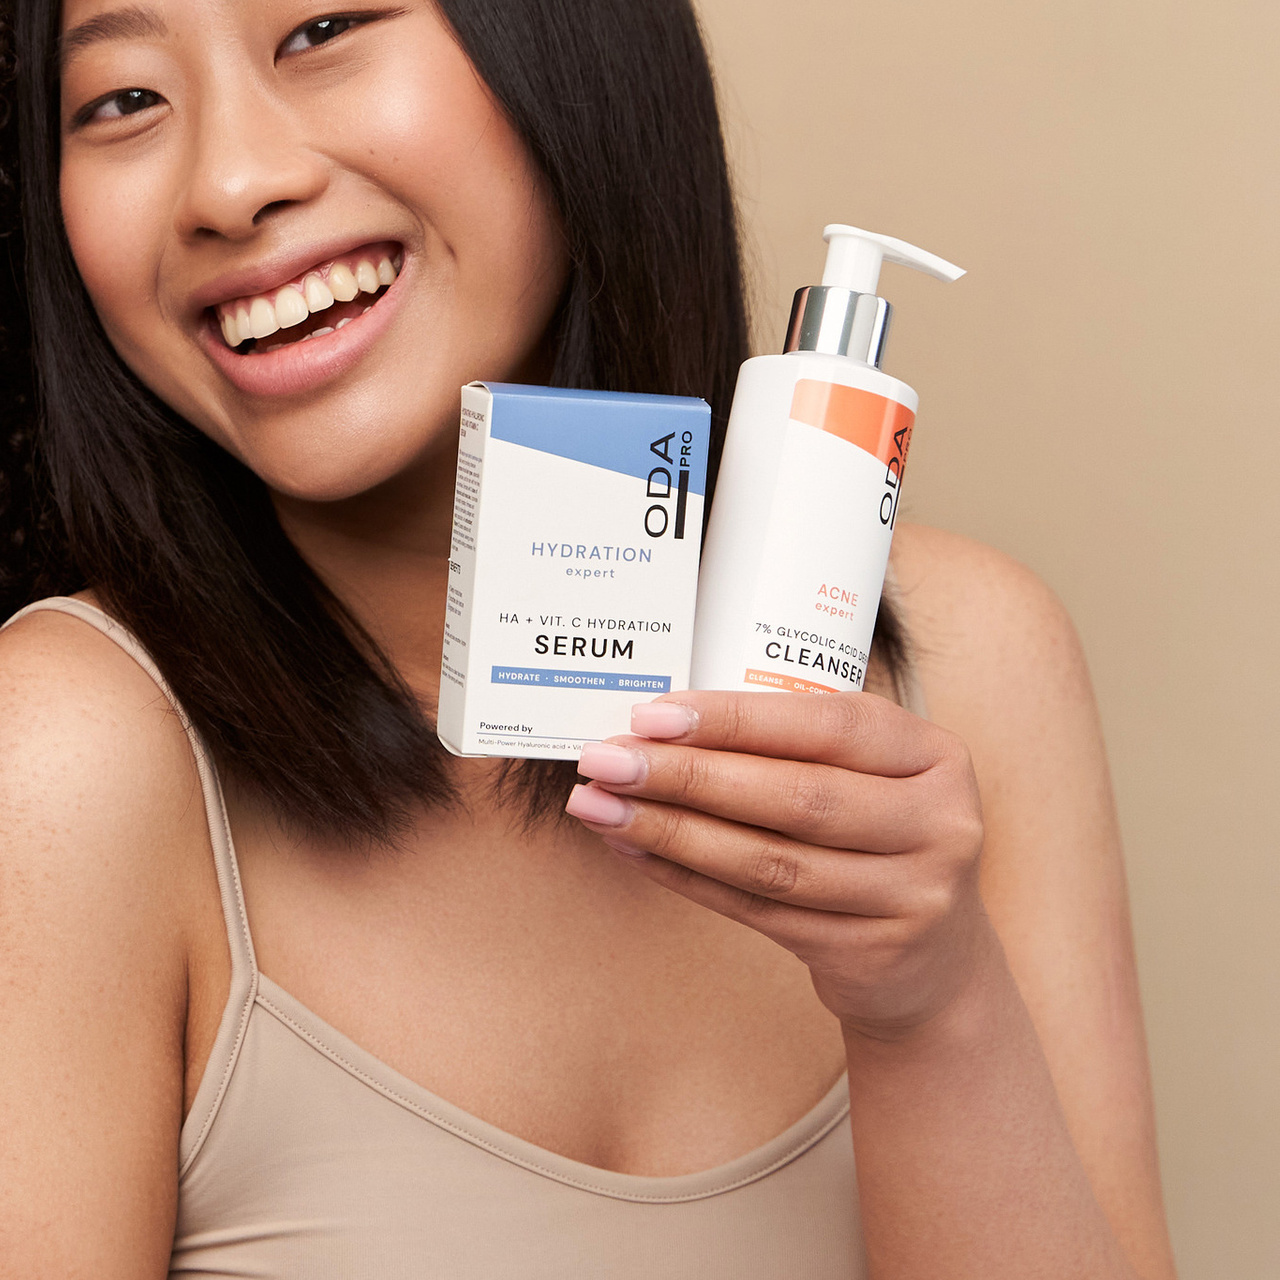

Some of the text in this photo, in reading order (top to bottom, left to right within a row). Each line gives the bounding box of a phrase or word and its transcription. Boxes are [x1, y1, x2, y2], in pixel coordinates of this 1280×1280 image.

[680, 430, 693, 468] PRO
[644, 431, 676, 538] ODA
[880, 426, 908, 526] ODA
[531, 542, 652, 563] HYDRATION
[566, 566, 616, 579] expert
[817, 584, 858, 606] ACNE
[815, 602, 854, 621] expert
[498, 612, 672, 633] HA + VIT. C HYDRATION
[534, 634, 634, 660] SERUM
[755, 622, 772, 634] 7%
[776, 626, 836, 649] GLYCOLIC
[838, 642, 858, 658] ACID
[765, 642, 863, 687] CLEANSER
[498, 672, 664, 689] HYDRATE SMOOTHEN BRIGHTEN
[748, 674, 784, 686] CLEANSE
[480, 722, 533, 734] Powered by
[478, 738, 516, 747] Multi-Power
[518, 741, 550, 750] Hyaluronic
